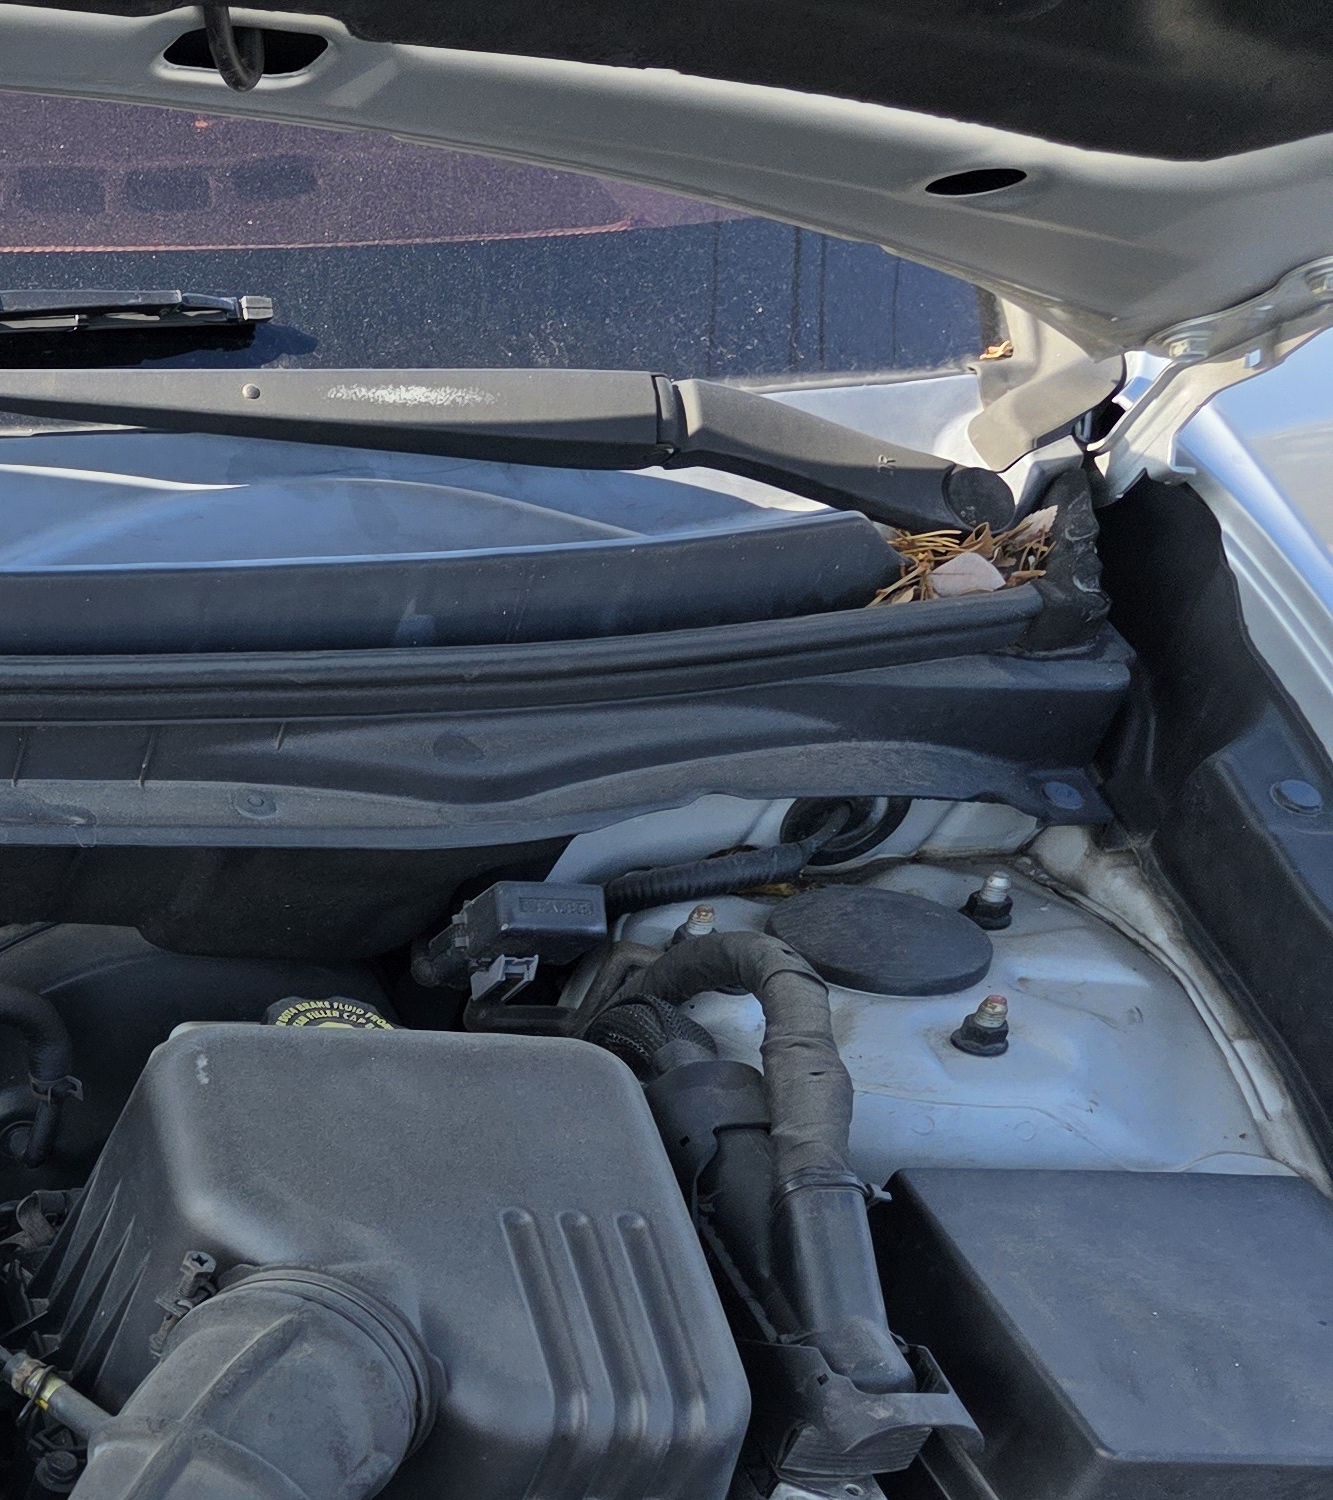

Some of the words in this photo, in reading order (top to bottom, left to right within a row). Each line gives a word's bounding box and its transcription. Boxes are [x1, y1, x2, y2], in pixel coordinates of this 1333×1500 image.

[296, 1000, 331, 1012] BRAKE
[333, 1001, 365, 1015] FLUID
[306, 1009, 340, 1020] FILLER
[343, 1012, 367, 1024] CAP
